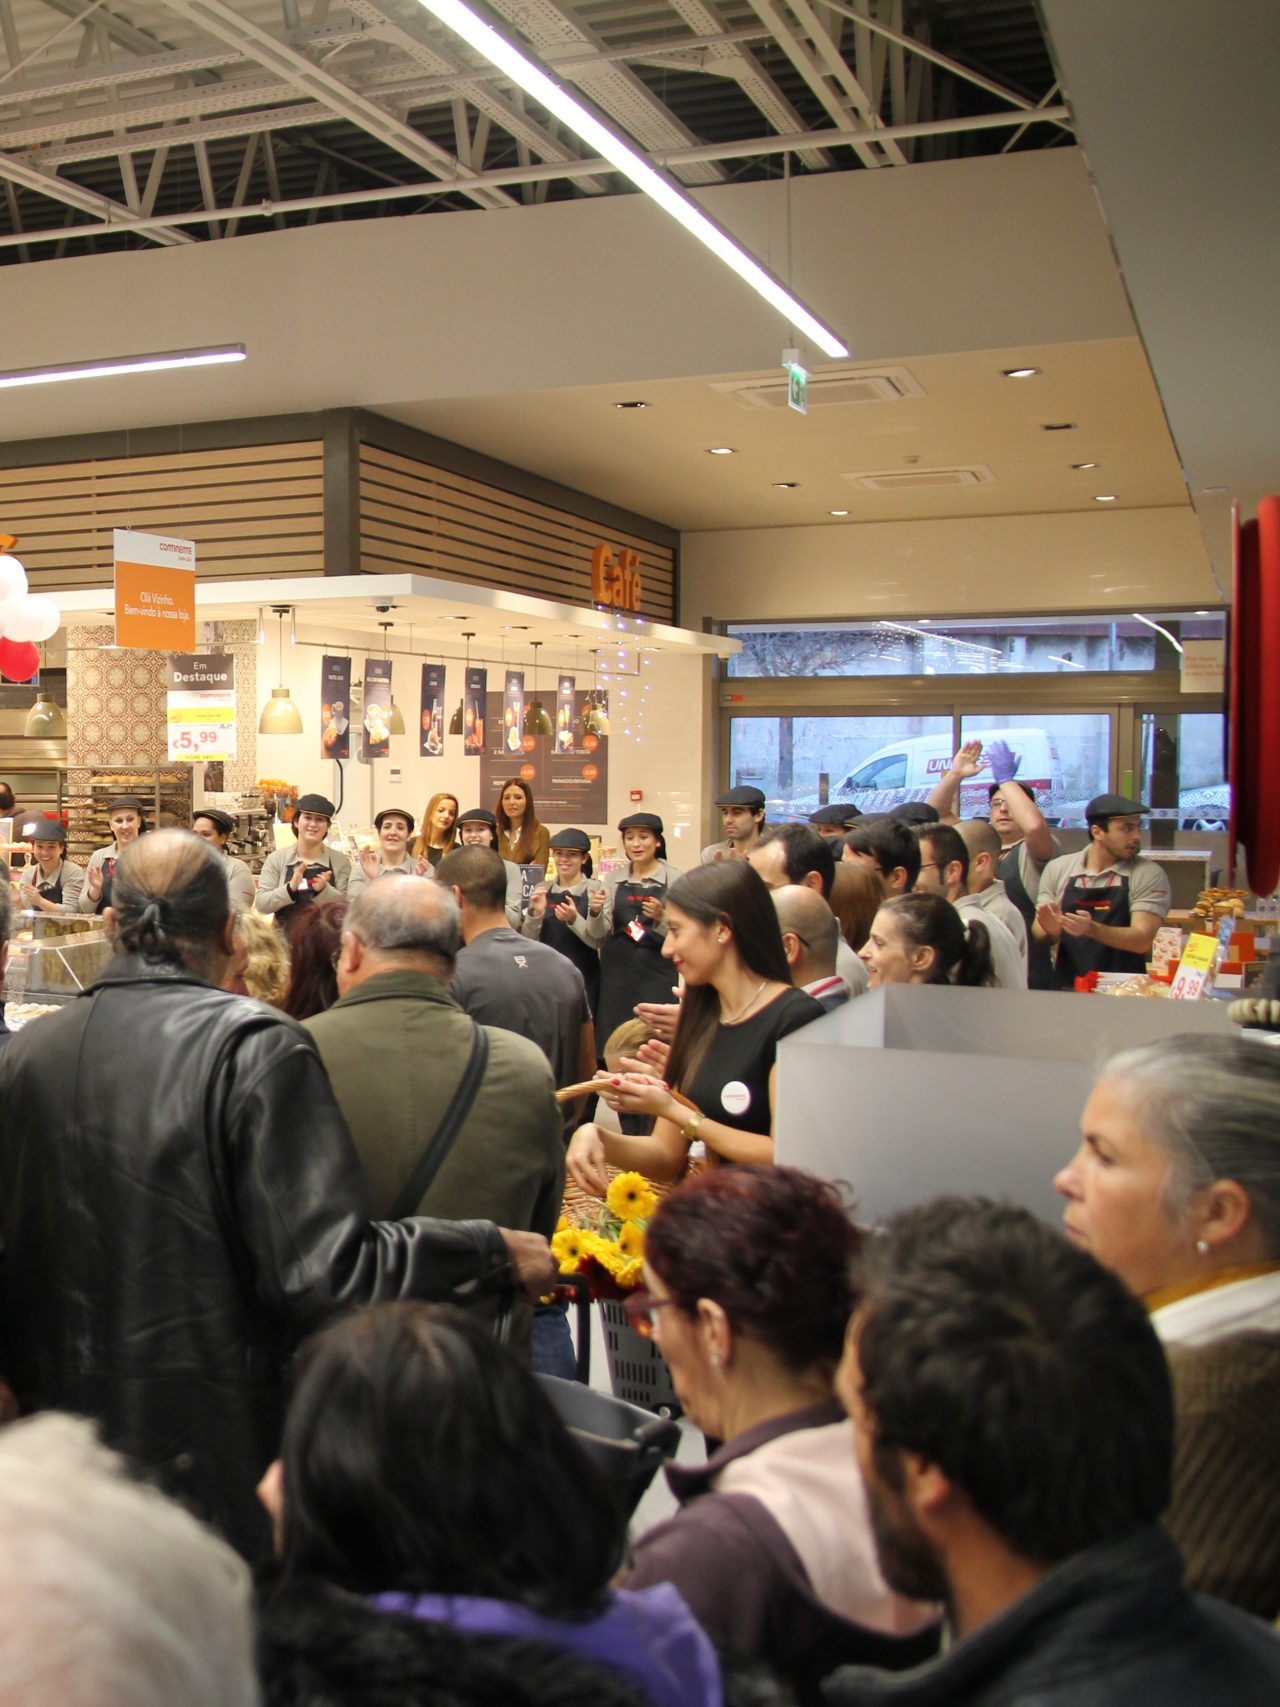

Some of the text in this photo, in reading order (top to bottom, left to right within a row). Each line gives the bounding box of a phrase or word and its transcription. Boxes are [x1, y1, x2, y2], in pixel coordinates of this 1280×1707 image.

[591, 544, 641, 611] Café
[140, 591, 151, 603] Olá
[124, 603, 156, 618] Bem-vindo
[162, 610, 178, 619] nossa
[193, 661, 207, 670] Em
[173, 672, 228, 684] Destaque
